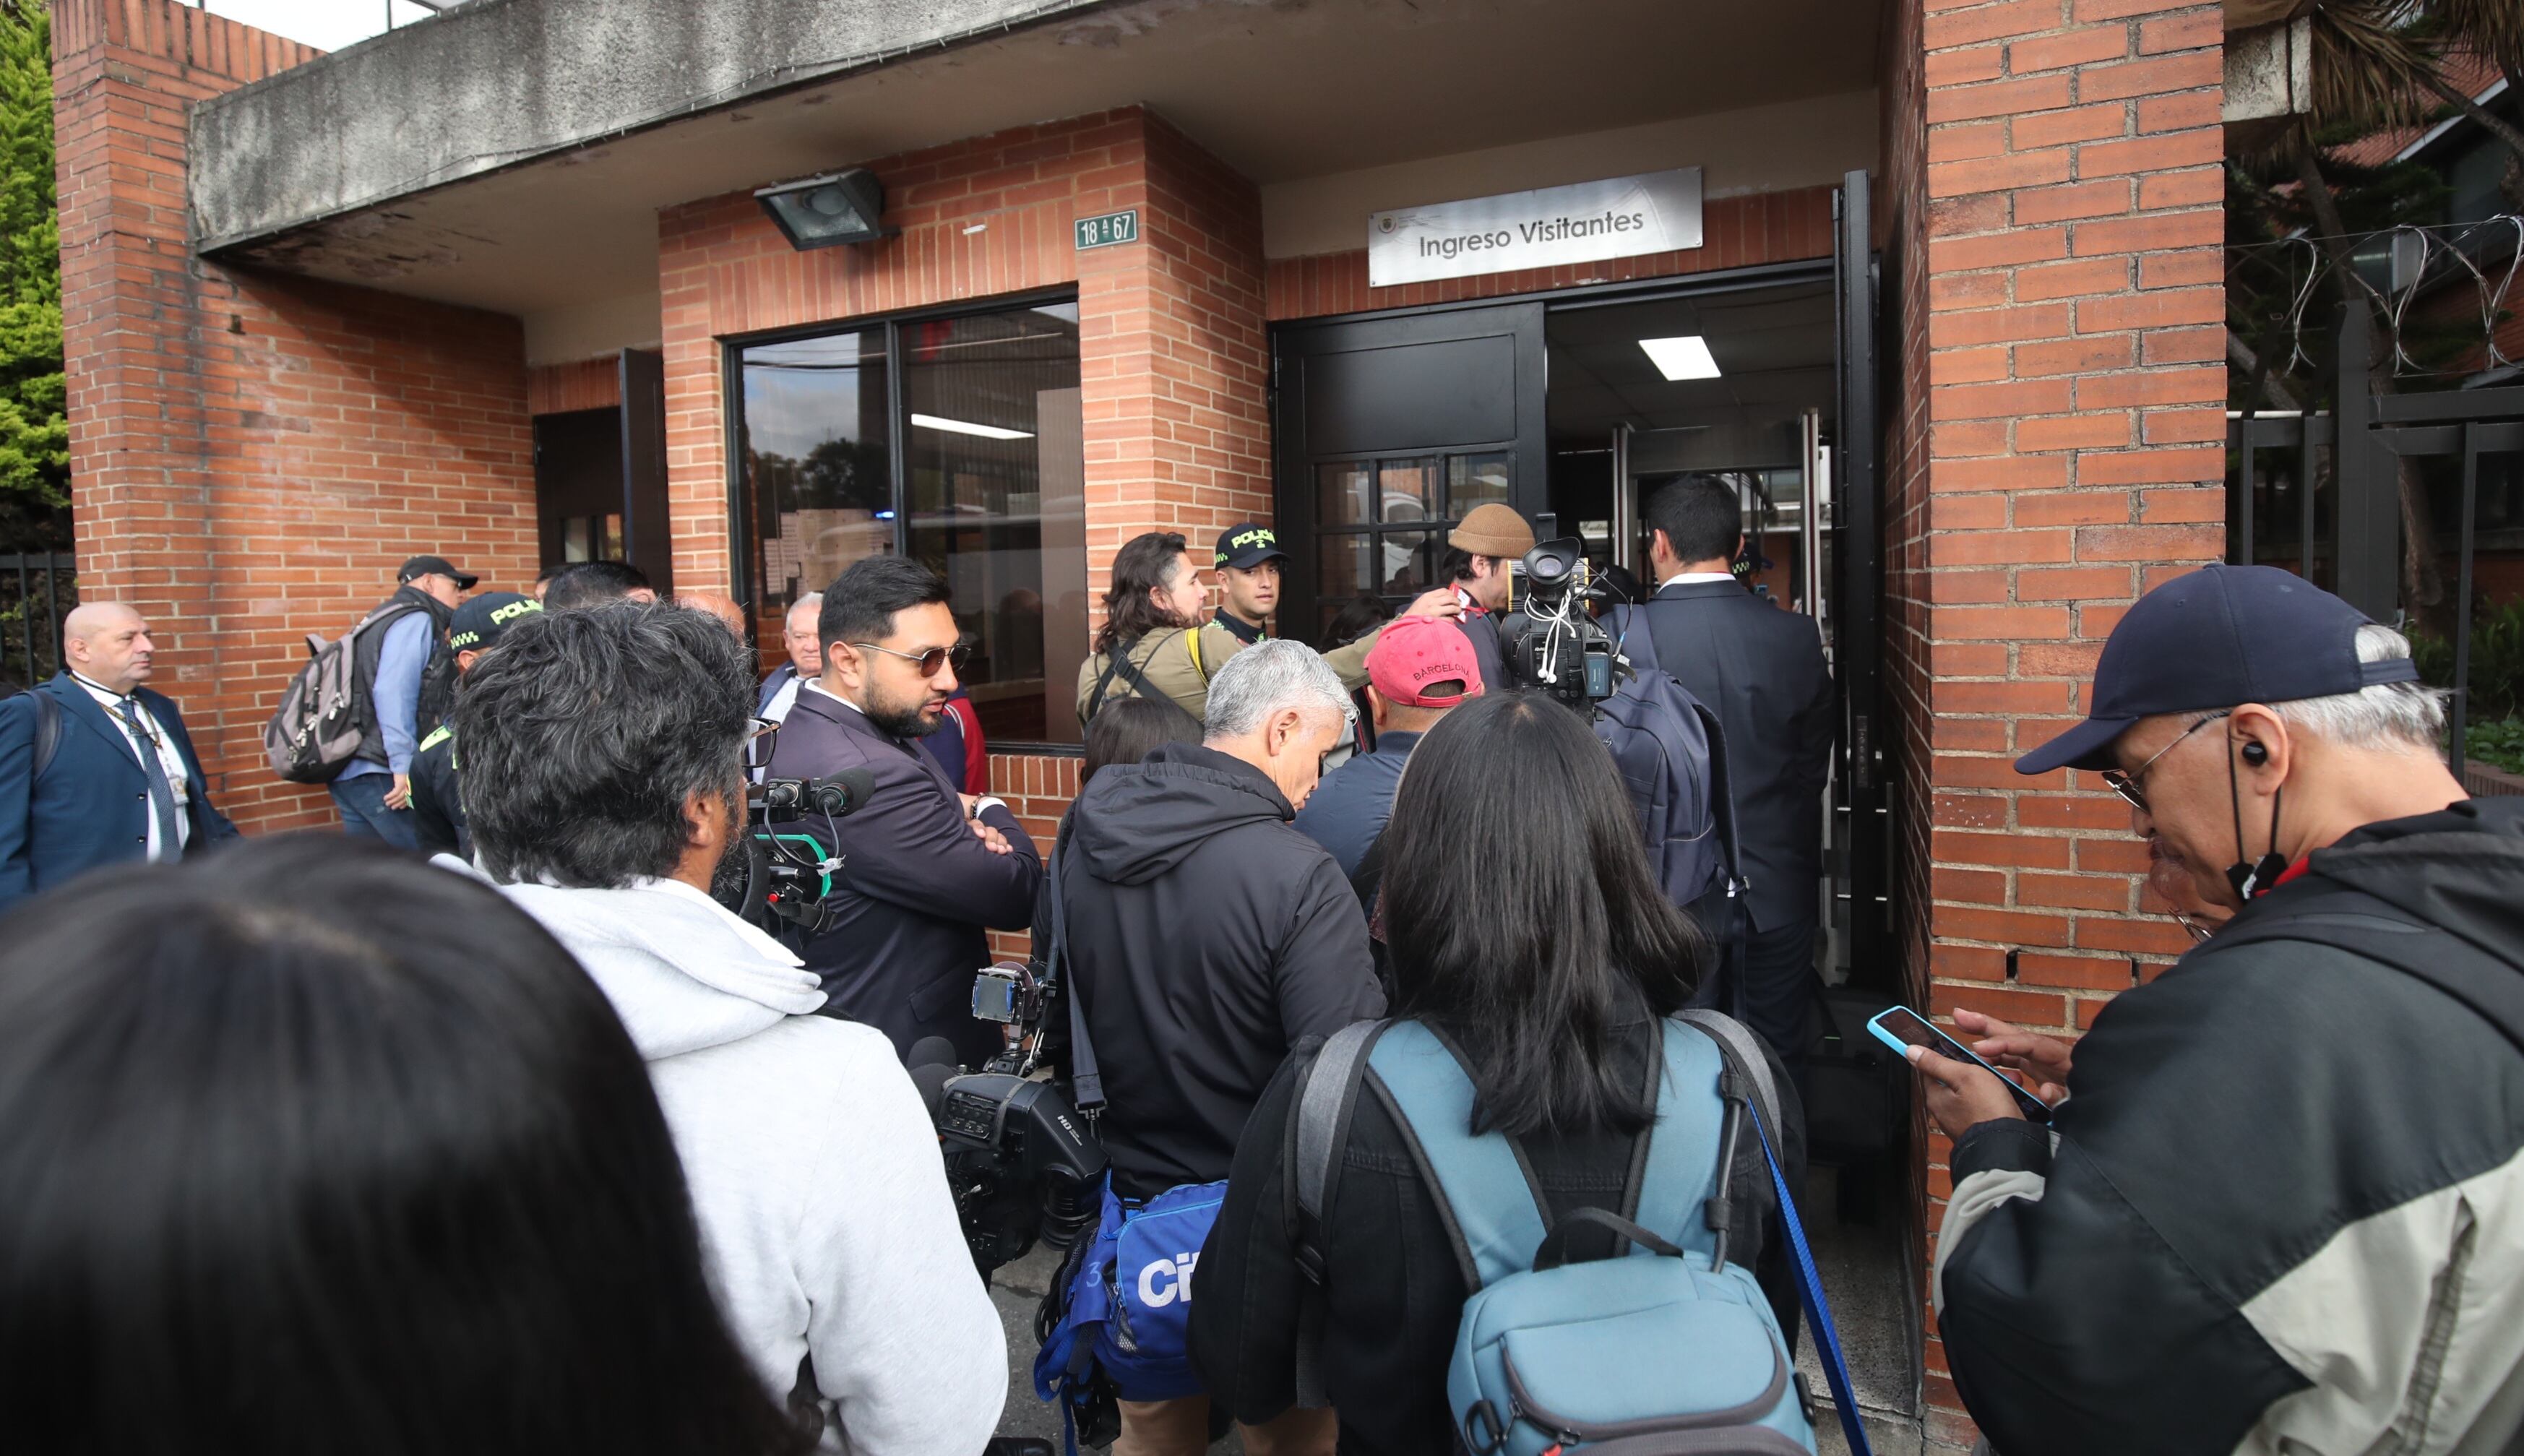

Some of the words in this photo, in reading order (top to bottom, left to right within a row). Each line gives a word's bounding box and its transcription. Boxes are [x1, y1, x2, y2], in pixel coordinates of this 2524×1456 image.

[1081, 221, 1098, 244] 18
[1114, 215, 1130, 239] 67
[1420, 230, 1512, 259] Ingreso
[1519, 211, 1644, 244] Visitantes
[1413, 663, 1470, 681] BARCELONA
[1057, 1115, 1072, 1131] HD
[1086, 1261, 1102, 1288] 3
